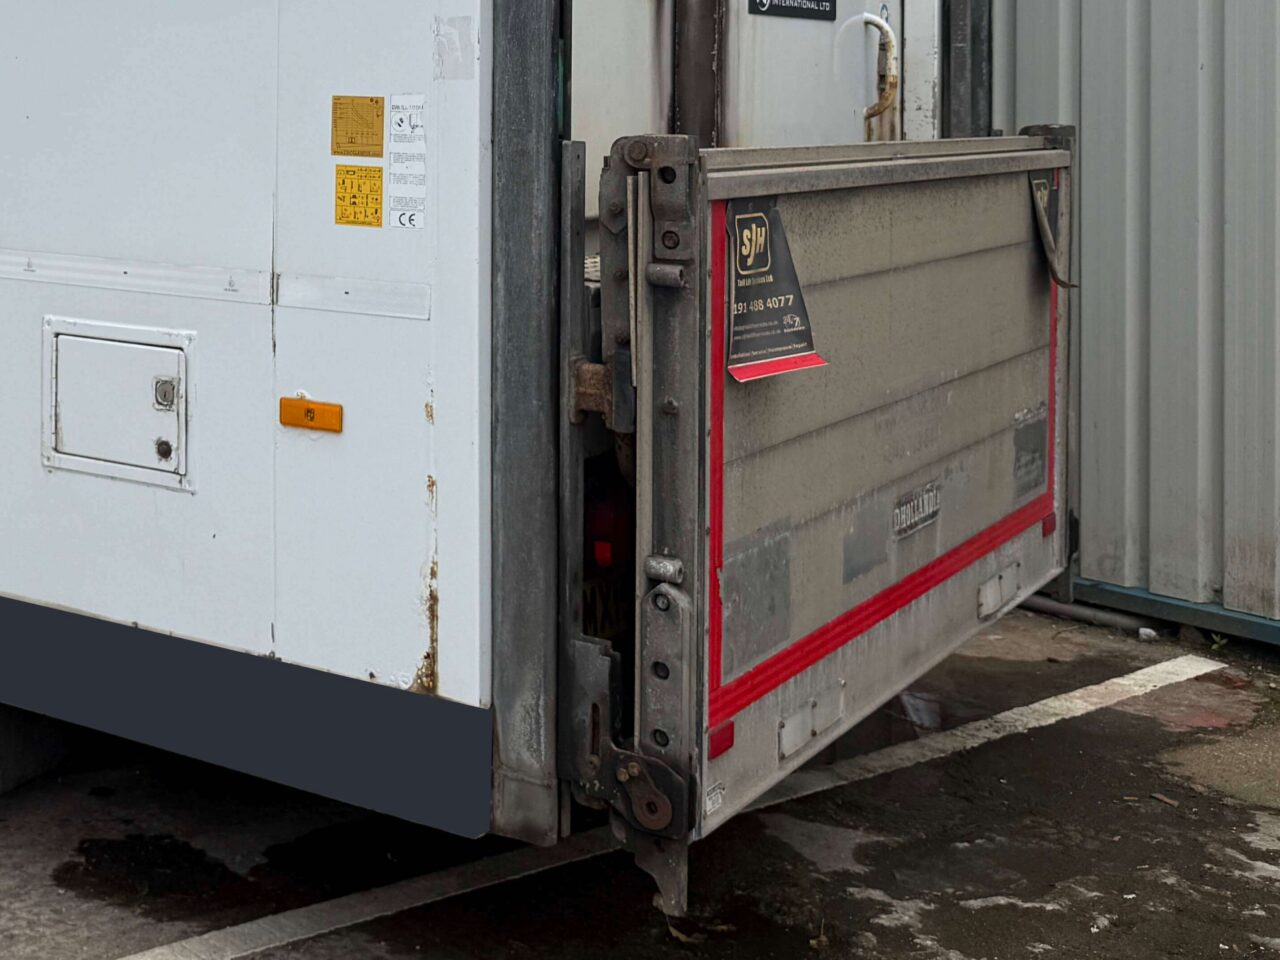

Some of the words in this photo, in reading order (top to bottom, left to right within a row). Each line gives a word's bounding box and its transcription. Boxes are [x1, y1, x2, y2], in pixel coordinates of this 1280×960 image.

[819, 2, 830, 11] LTD
[741, 223, 766, 267] SJH
[749, 299, 764, 312] 488
[766, 294, 794, 310] 4077
